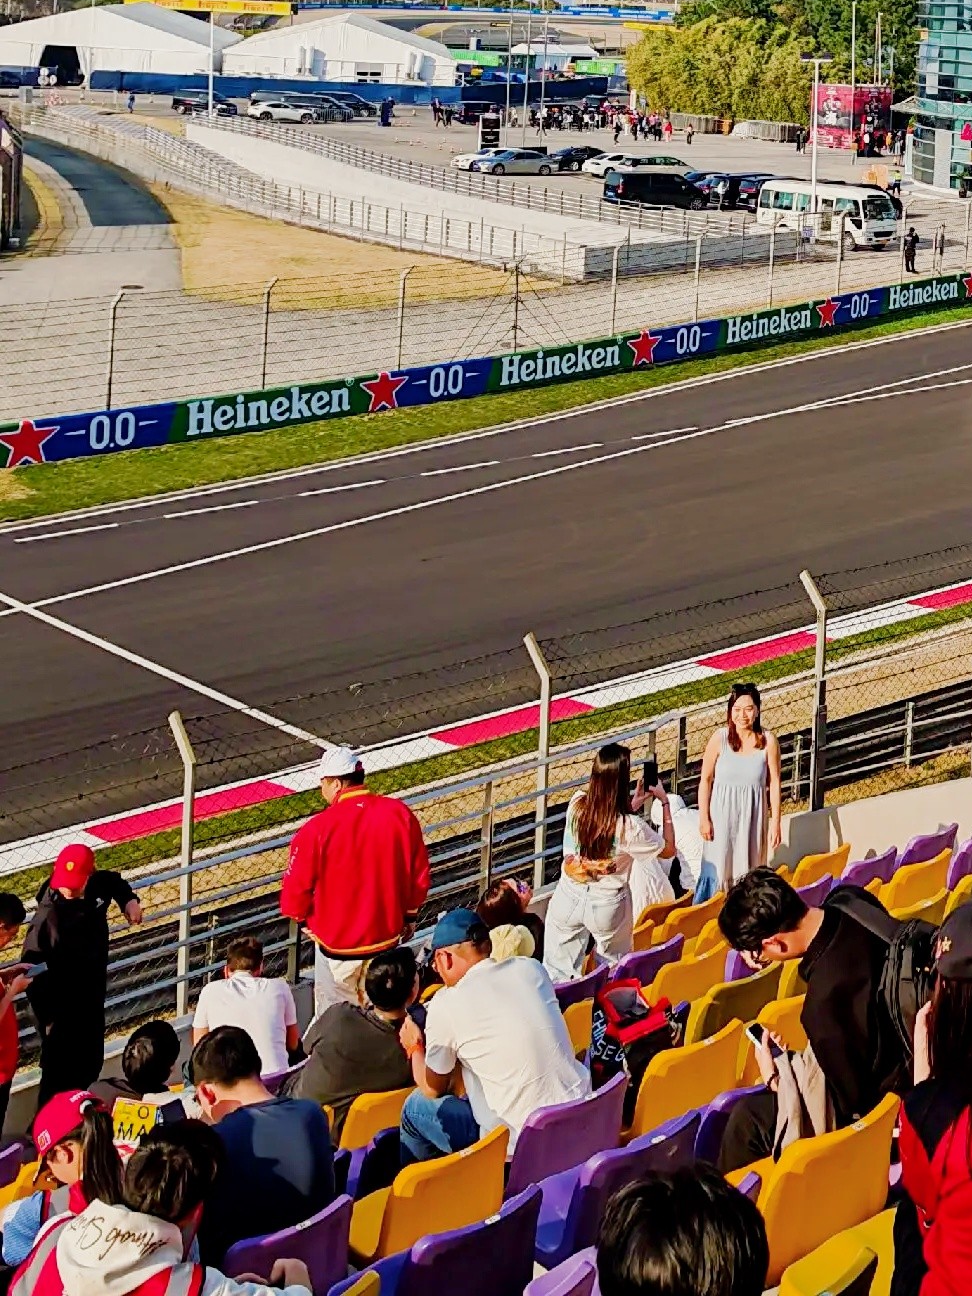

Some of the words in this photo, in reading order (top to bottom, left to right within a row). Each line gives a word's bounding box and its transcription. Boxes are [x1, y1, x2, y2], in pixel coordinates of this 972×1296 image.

[888, 279, 959, 310] Heineken
[726, 308, 811, 344] Heineken
[429, 365, 464, 398] 0.0
[500, 344, 621, 386] Heineken
[187, 386, 350, 436] Heineken
[89, 411, 136, 450] 0.0
